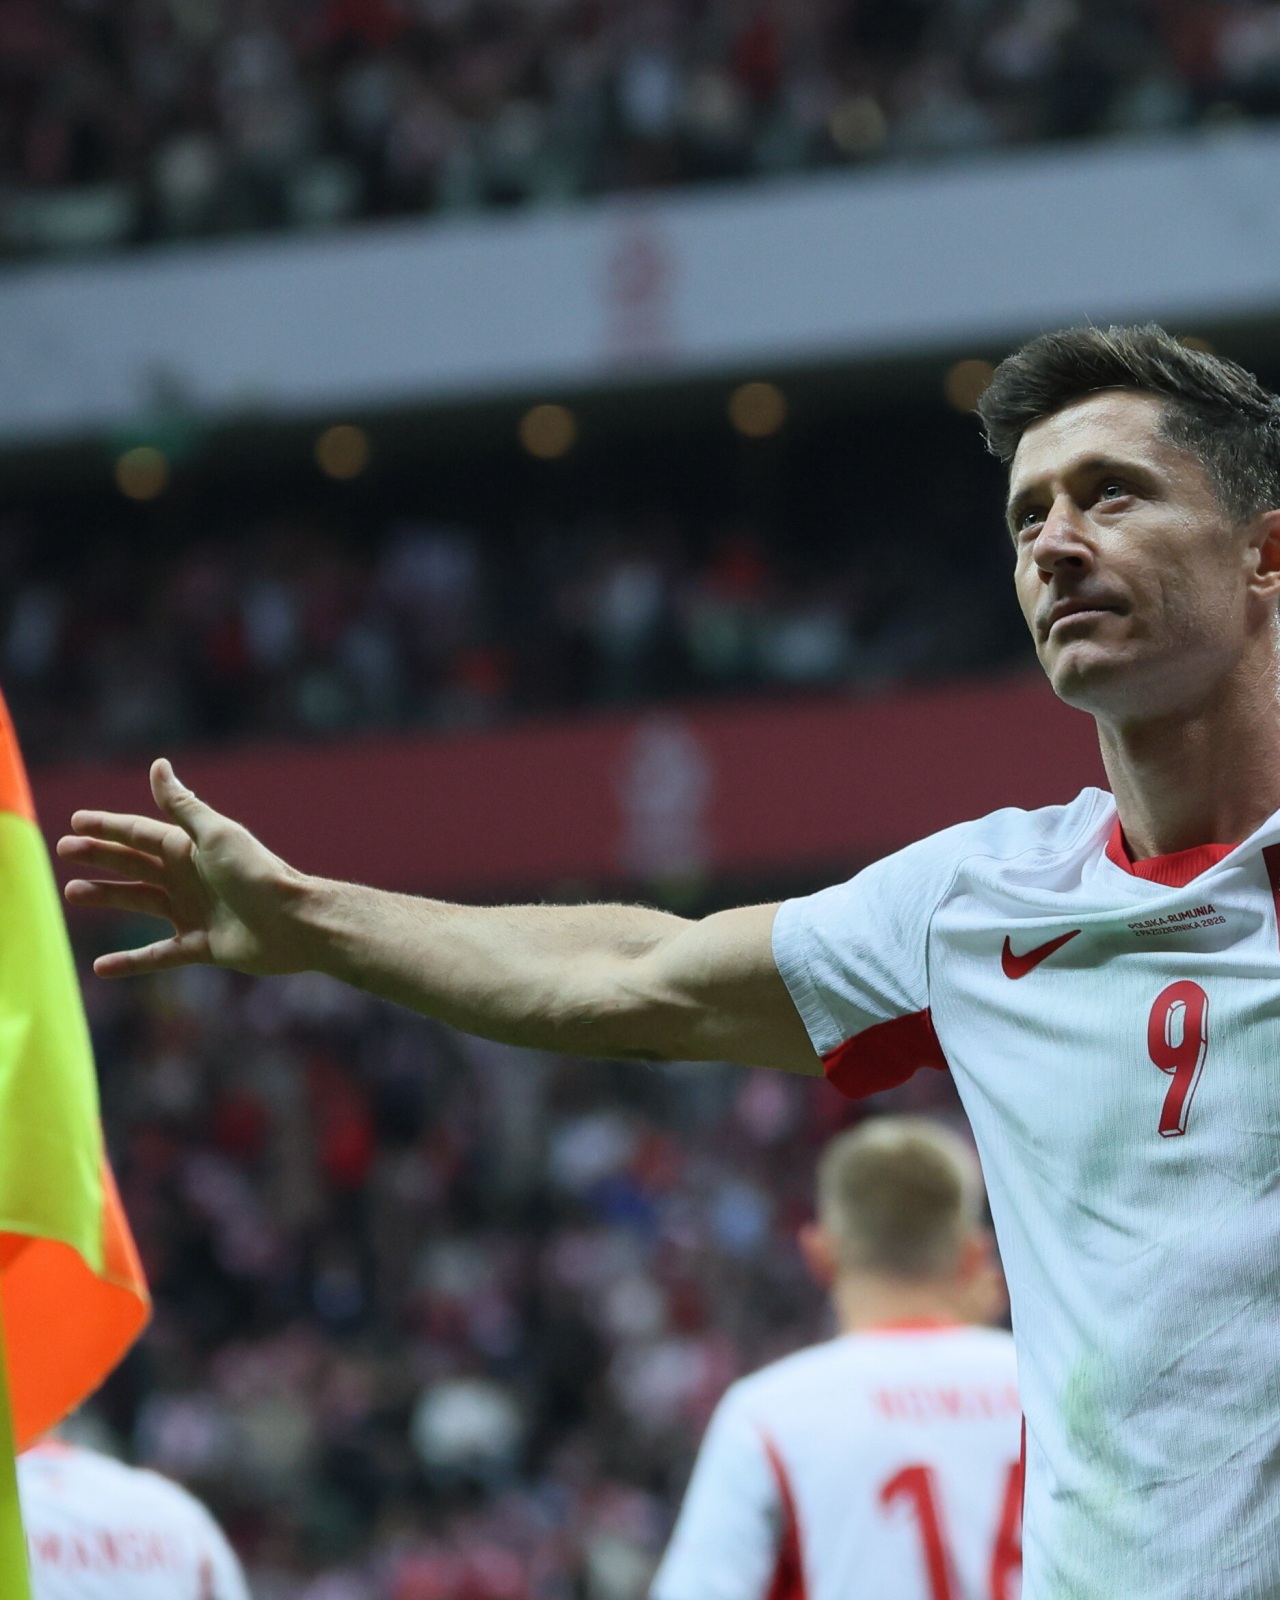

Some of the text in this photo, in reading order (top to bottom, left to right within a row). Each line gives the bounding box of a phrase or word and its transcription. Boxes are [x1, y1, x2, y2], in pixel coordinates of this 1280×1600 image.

[1127, 904, 1216, 929] POLSKA-RUMUNIA
[1200, 915, 1227, 928] 2026
[1148, 980, 1209, 1138] 9
